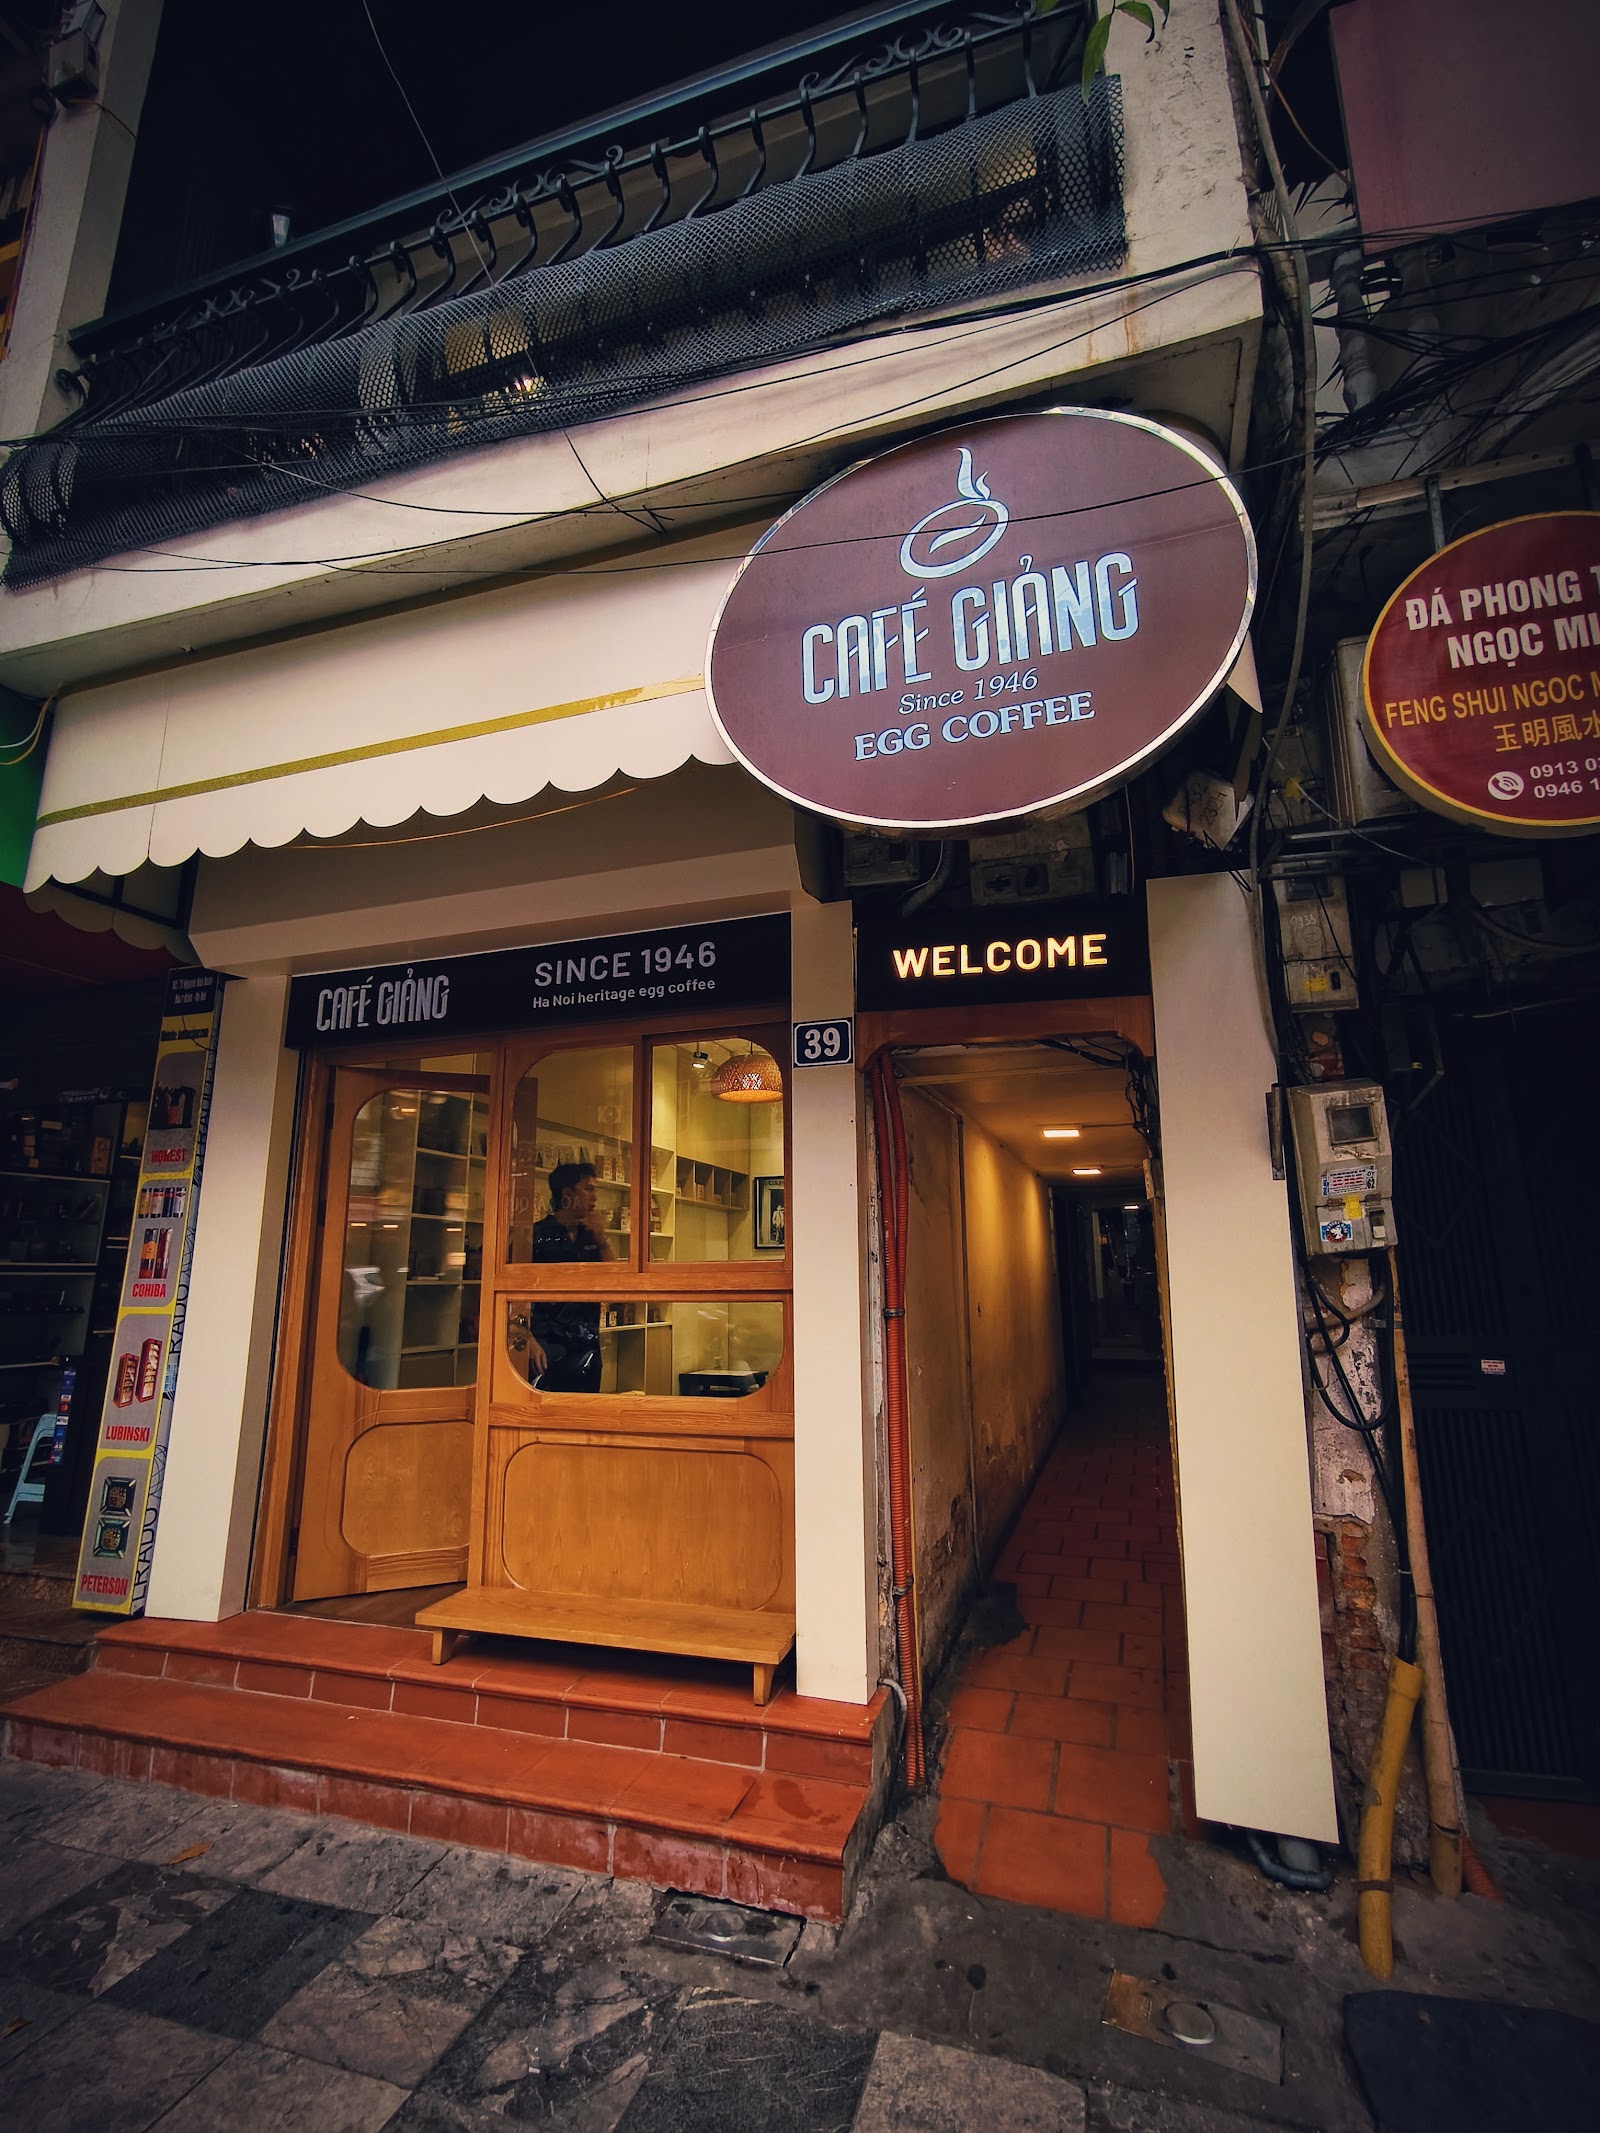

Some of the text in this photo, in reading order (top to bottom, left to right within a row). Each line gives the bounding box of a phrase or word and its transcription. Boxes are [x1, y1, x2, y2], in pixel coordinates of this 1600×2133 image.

[1405, 587, 1452, 631] ĐÁ
[1459, 570, 1583, 622] PHONG
[802, 551, 1139, 705] CAFÉ GIẢNG
[1447, 623, 1544, 669] NGỌC
[898, 666, 1039, 715] Since 1946
[1385, 696, 1447, 729] FENG
[1453, 686, 1507, 719] SHUI
[1513, 673, 1584, 711] NGOC
[854, 691, 1096, 761] EGG COFFEE
[1529, 757, 1600, 779] 0913 0
[1534, 779, 1583, 799] 0946
[534, 941, 717, 987] SINCE 1946
[892, 933, 1108, 979] WELCOME
[316, 968, 450, 1031] CAFÉ GIẢNG
[533, 978, 716, 1009] Ha Noi heritage egg coffee
[803, 1027, 841, 1060] 39
[132, 1283, 166, 1298] COHIBA
[105, 1426, 150, 1443] LUBINSKI
[80, 1574, 129, 1597] PETERSON
